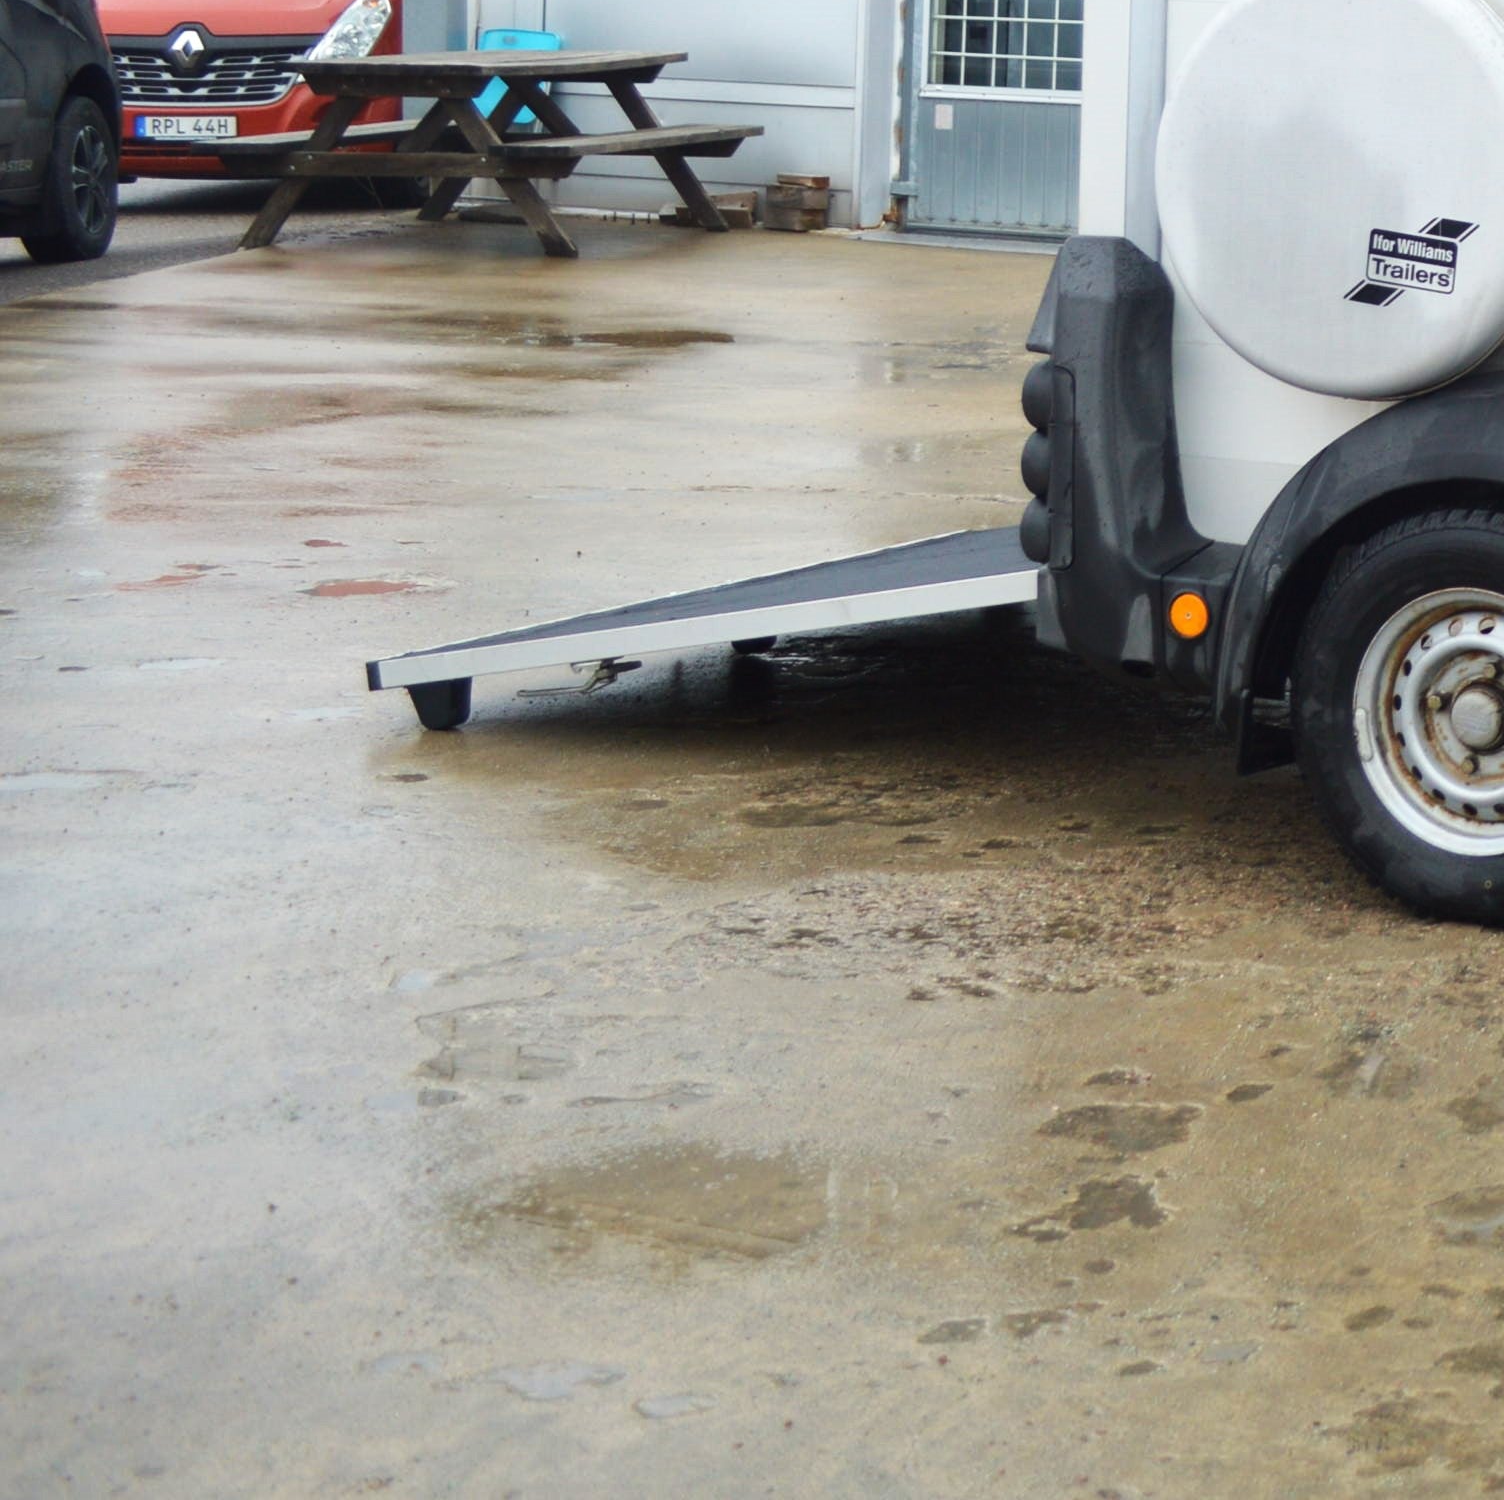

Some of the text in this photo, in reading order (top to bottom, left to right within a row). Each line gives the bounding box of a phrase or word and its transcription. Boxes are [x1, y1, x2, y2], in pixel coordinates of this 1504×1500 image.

[152, 118, 229, 134] RPL 44H
[1374, 235, 1453, 262] Ifor Williams
[1371, 257, 1450, 287] Trailers
